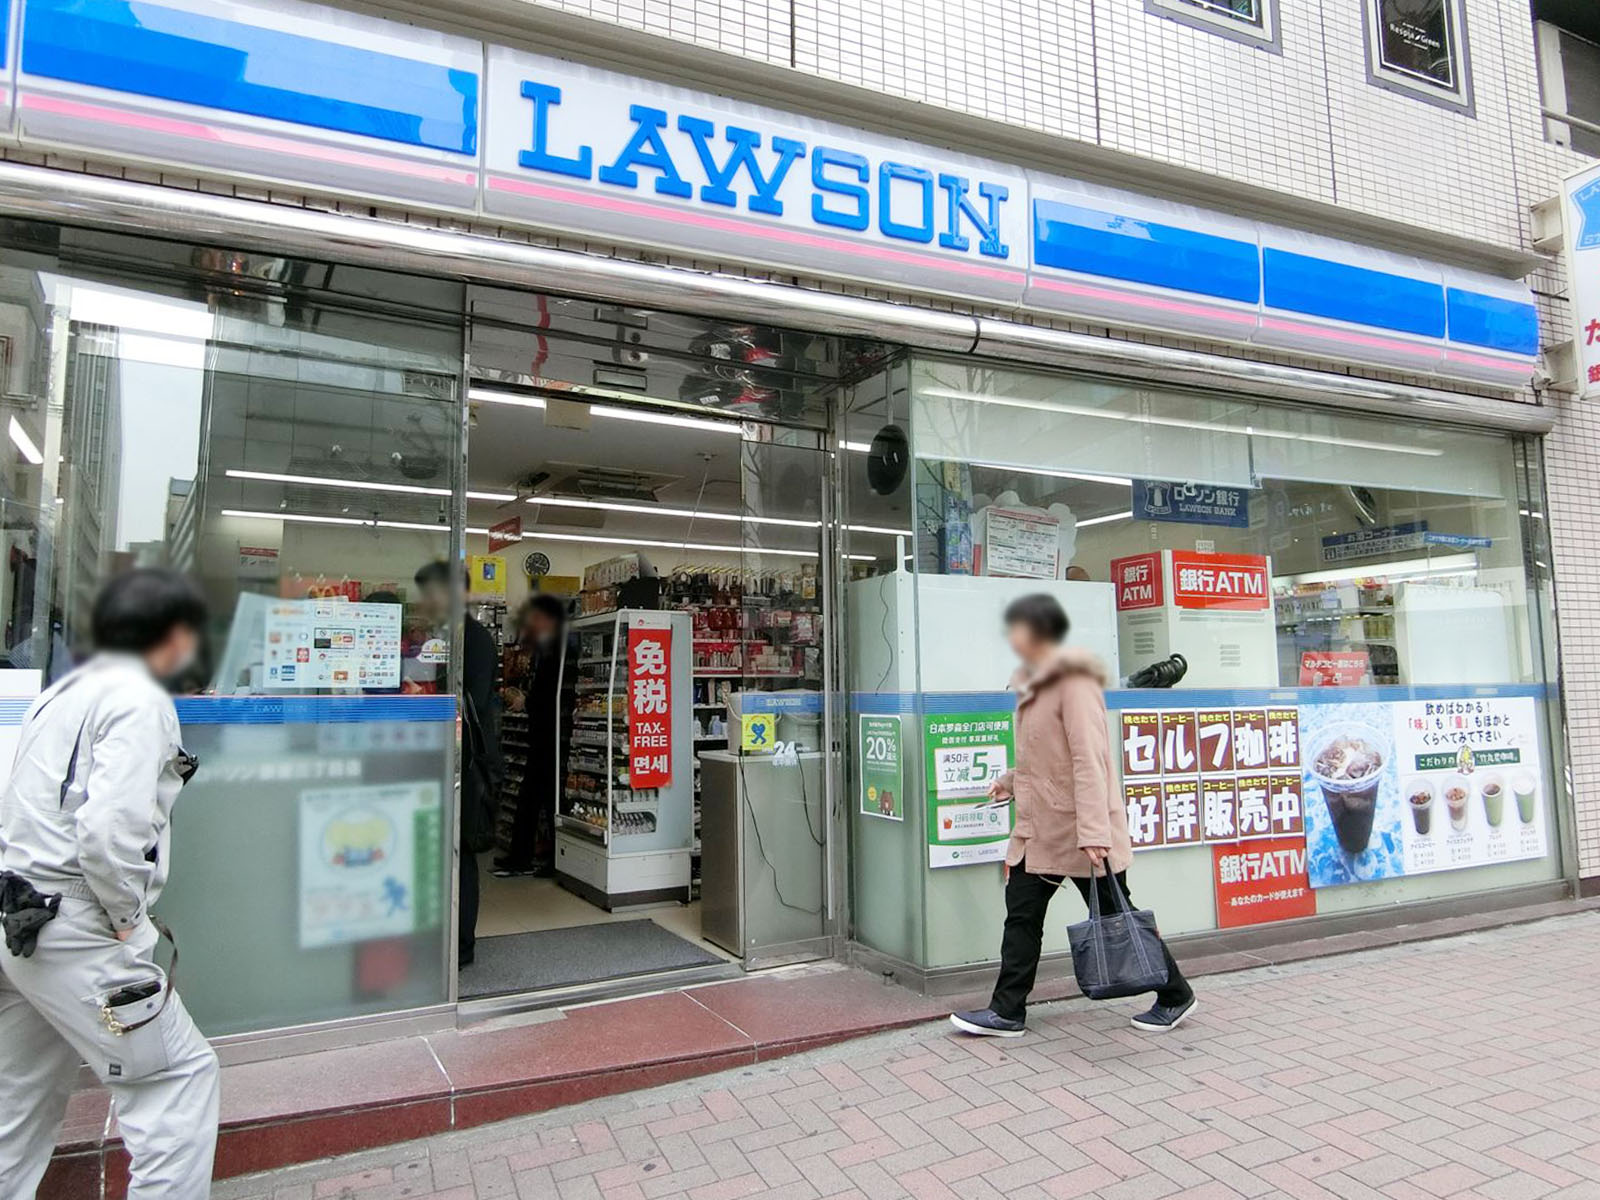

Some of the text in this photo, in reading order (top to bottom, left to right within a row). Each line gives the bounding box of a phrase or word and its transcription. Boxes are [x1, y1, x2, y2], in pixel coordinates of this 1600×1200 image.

[517, 79, 1009, 258] LAWSON
[1174, 486, 1240, 507] ロソン銀行
[1213, 506, 1237, 517] BANK
[1123, 564, 1149, 584] 銀行
[1179, 568, 1263, 595] 銀行ATM
[1122, 584, 1152, 602] ATM
[633, 639, 668, 715] 免税
[1234, 711, 1265, 721] コーヒー
[1425, 701, 1491, 715] 飲めばわかる！
[1163, 714, 1194, 724] コーヒー
[635, 722, 666, 735] TAX-
[634, 735, 668, 748] FREE
[1123, 720, 1298, 772] セルフ珈琲
[1423, 730, 1502, 746] くらべてみて下さい
[773, 741, 796, 757] 24
[866, 737, 897, 760] 20%
[634, 754, 668, 775] 면세
[1420, 756, 1456, 767] こだわりの
[1203, 781, 1235, 791] コーヒー
[1271, 777, 1300, 786] コーヒー
[1126, 786, 1161, 796] コーヒー
[1127, 786, 1300, 843] 好評販売中
[1219, 848, 1306, 884] 銀行ATM
